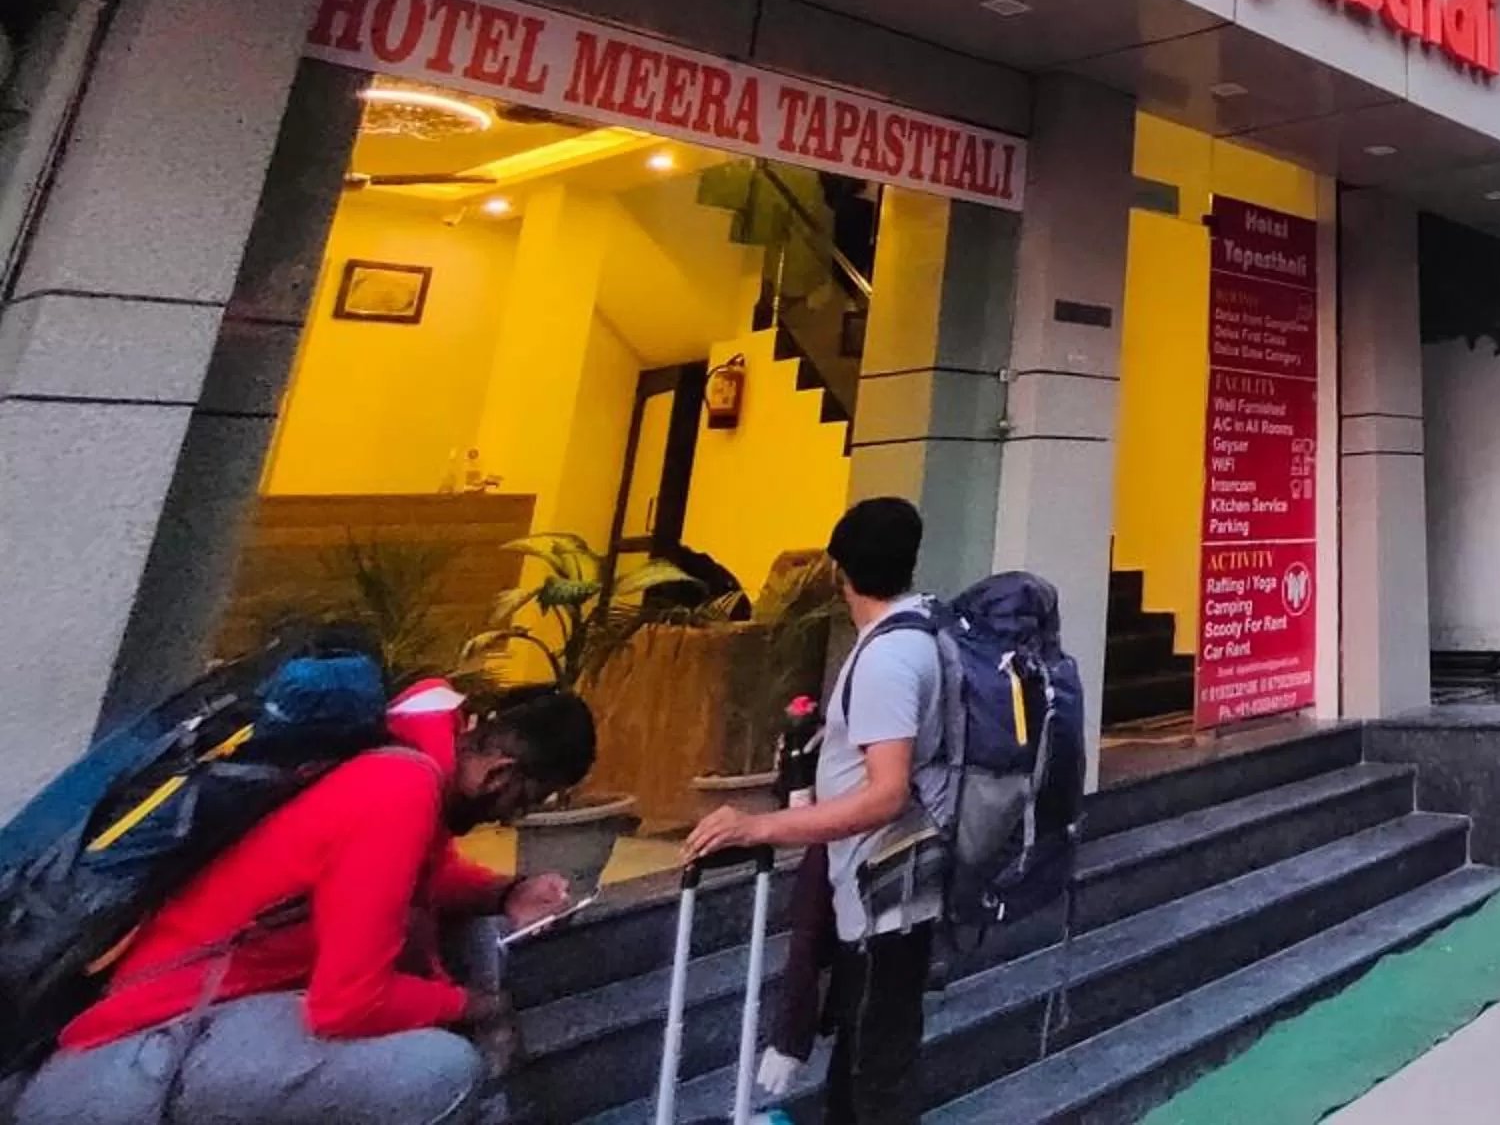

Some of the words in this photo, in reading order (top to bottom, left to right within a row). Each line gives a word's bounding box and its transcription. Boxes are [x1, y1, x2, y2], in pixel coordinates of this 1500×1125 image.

[565, 32, 762, 144] MEERA
[778, 88, 1015, 201] TAPASTHALI
[1246, 209, 1288, 239] Hotel
[1261, 418, 1293, 436] Rooms
[1213, 437, 1249, 456] Geyser
[1211, 497, 1250, 513] Kitchen
[1252, 496, 1288, 513] Service
[1210, 518, 1249, 536] Parking
[1208, 551, 1274, 572] ACTIVITY
[1206, 576, 1244, 595] Rafting
[1252, 575, 1276, 593] Yoga
[1206, 597, 1253, 617] Camping
[1205, 621, 1242, 639] Scooty
[1244, 617, 1262, 634] For
[1264, 615, 1287, 631] Rent
[1204, 643, 1224, 660] Car
[1226, 640, 1251, 657] Rent
